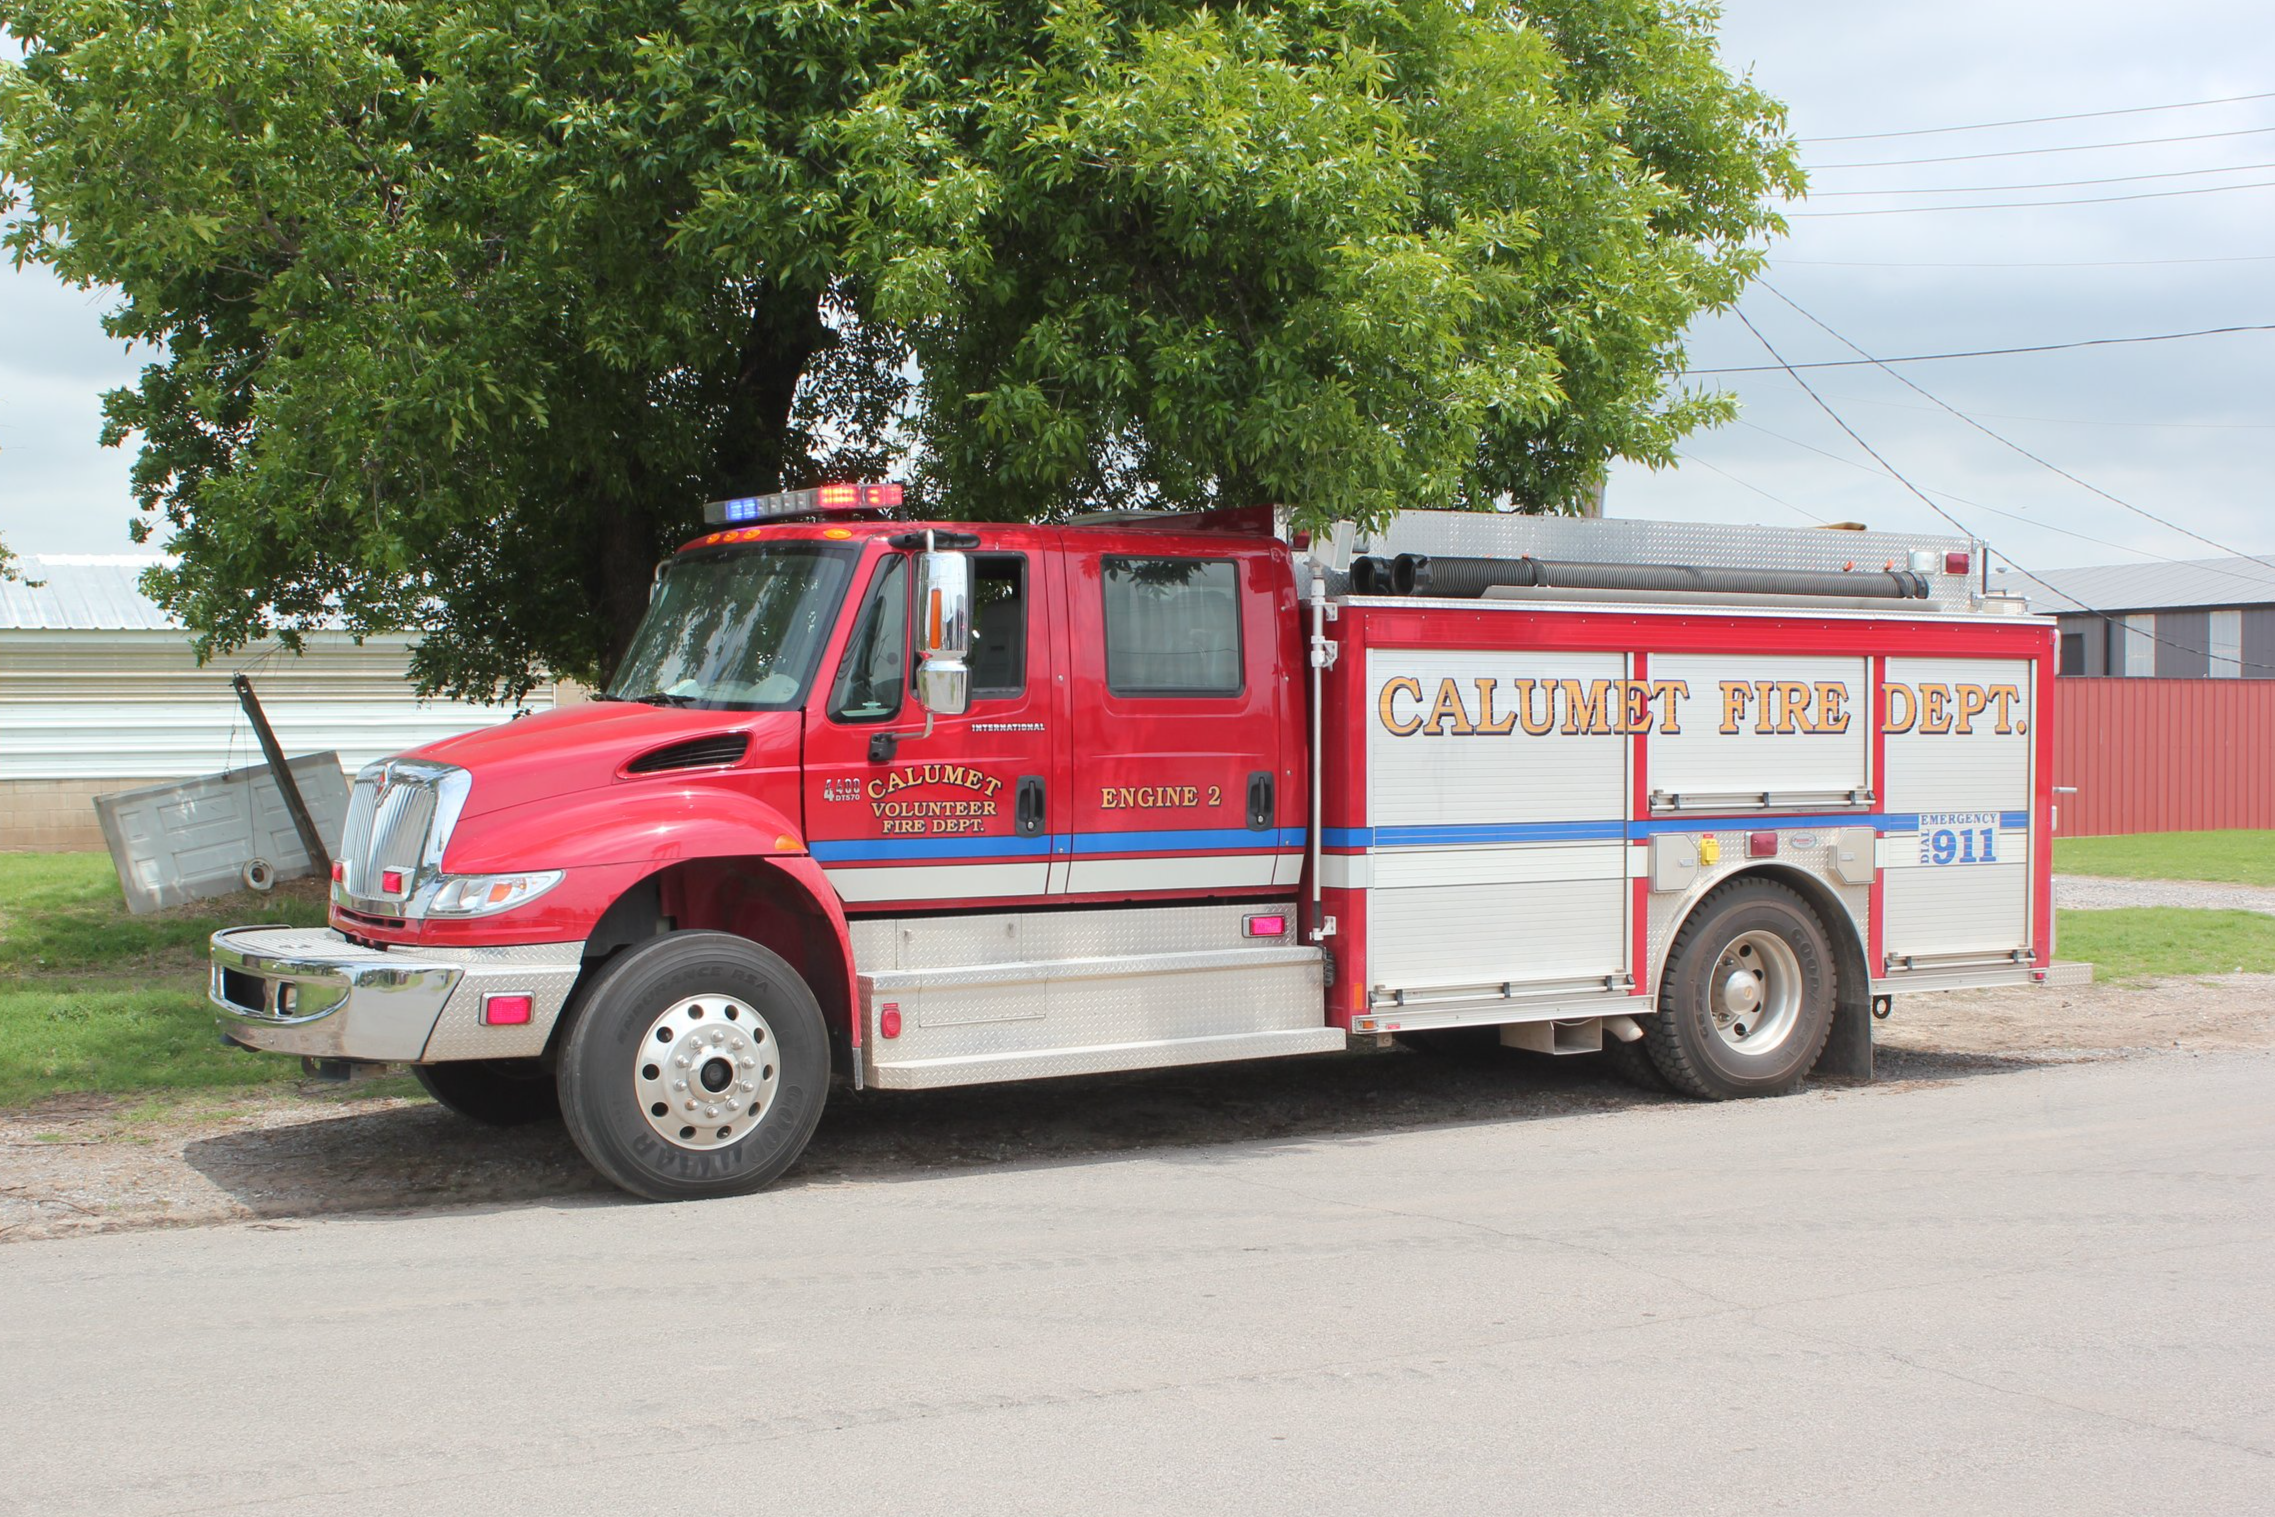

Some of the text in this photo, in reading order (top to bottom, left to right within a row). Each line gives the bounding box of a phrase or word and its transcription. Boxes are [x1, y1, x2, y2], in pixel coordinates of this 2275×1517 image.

[1378, 676, 2028, 736] CALUMET FIRE DEPT.
[971, 722, 1046, 733] INTERNATIONAL
[823, 777, 861, 802] 4400
[866, 763, 1003, 800] CALUMET
[870, 800, 998, 818] VOLUNTEER
[1100, 784, 1222, 809] ENGINE 2
[881, 818, 986, 835] FIRE DEPT.
[1920, 812, 1997, 826] EMERGENCY
[1919, 828, 1931, 865] DIAL
[1931, 827, 1997, 866] 911
